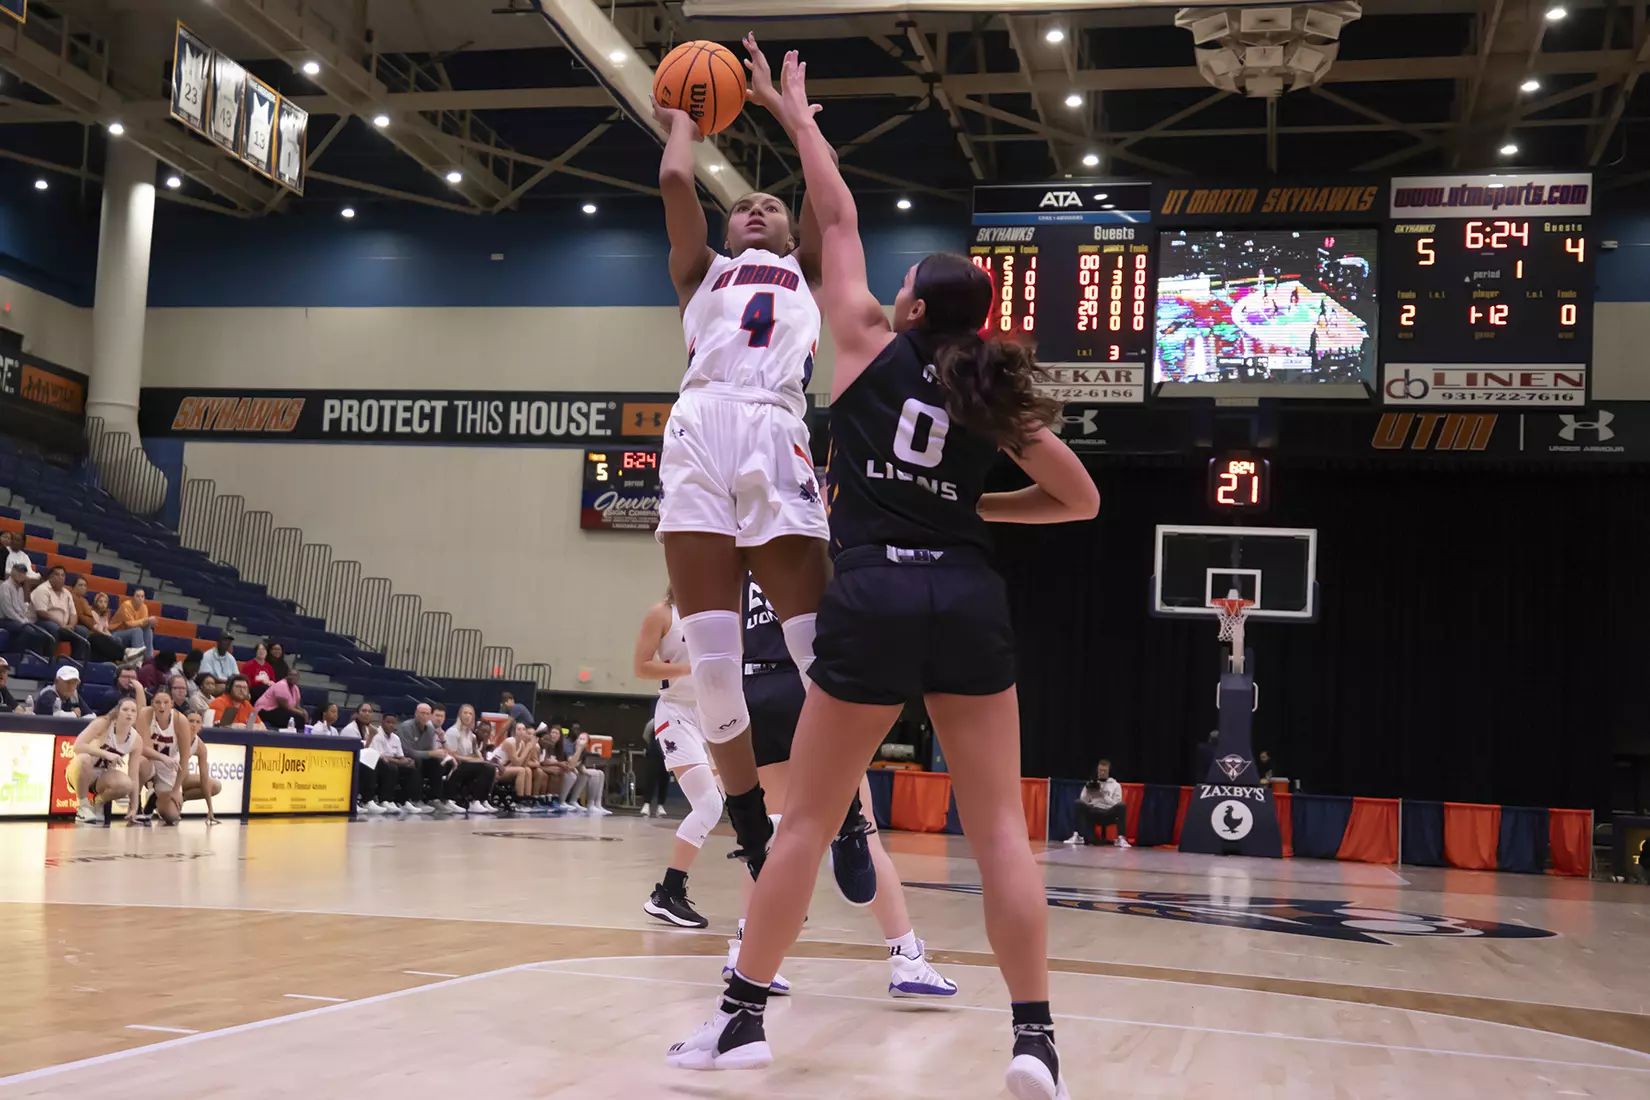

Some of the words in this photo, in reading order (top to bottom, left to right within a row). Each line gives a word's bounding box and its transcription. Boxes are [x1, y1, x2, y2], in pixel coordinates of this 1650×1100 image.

[185, 83, 197, 105] 23
[689, 83, 707, 121] Wil
[1039, 191, 1083, 207] ATA
[1160, 189, 1189, 214] UT
[1187, 188, 1257, 213] MARTIN
[1260, 186, 1379, 212] SKYHAWKS
[1394, 182, 1589, 210] www.utmsports.com
[976, 226, 1035, 242] SKYHAWKS
[1094, 226, 1135, 241] Guests
[1394, 224, 1436, 233] SKYHAWKS
[1465, 221, 1529, 249] 6:24
[1544, 222, 1583, 232] Guests
[1416, 238, 1436, 266] 5
[1564, 237, 1585, 263] 4
[1003, 256, 1014, 270] 2
[1031, 256, 1037, 269] 1
[1080, 255, 1100, 270] 00
[1117, 255, 1123, 269] 1
[1135, 254, 1146, 270] 0
[732, 264, 799, 292] MARTIN
[1003, 270, 1014, 285] 3
[1025, 270, 1036, 285] 0
[1079, 270, 1099, 285] 01
[1112, 270, 1123, 285] 3
[1134, 270, 1146, 285] 0
[1473, 269, 1501, 280] period
[1002, 285, 1013, 301] 0
[1024, 285, 1036, 301] 0
[1084, 285, 1098, 300] 10
[1110, 285, 1122, 301] 0
[1134, 285, 1145, 300] 0
[1001, 301, 1012, 316] 0
[1029, 301, 1035, 315] 1
[1078, 300, 1098, 316] 20
[1110, 300, 1122, 316] 0
[1133, 300, 1145, 316] 0
[1400, 304, 1416, 326] 2
[1560, 304, 1577, 326] 0
[739, 292, 776, 348] 4
[1000, 316, 1012, 331] 0
[1023, 316, 1034, 331] 0
[1077, 316, 1098, 331] 21
[1109, 316, 1121, 331] 0
[1132, 316, 1144, 331] 0
[1109, 345, 1120, 361] 3
[1433, 372, 1584, 387] LINEN
[1441, 392, 1574, 402] 931-722-7616
[171, 396, 306, 433] SKYHAWKS
[322, 398, 449, 435] PROTECT
[455, 400, 503, 434] THIS
[893, 397, 950, 468] 0
[1371, 412, 1498, 451] UTM
[623, 452, 656, 468] 6:24
[596, 463, 608, 481] 5
[1216, 472, 1259, 504] 21
[746, 611, 779, 630] LION
[60, 741, 76, 758] Sta
[591, 743, 602, 755] G
[281, 753, 306, 774] Jones
[1200, 785, 1265, 802] ZAXBY'S
